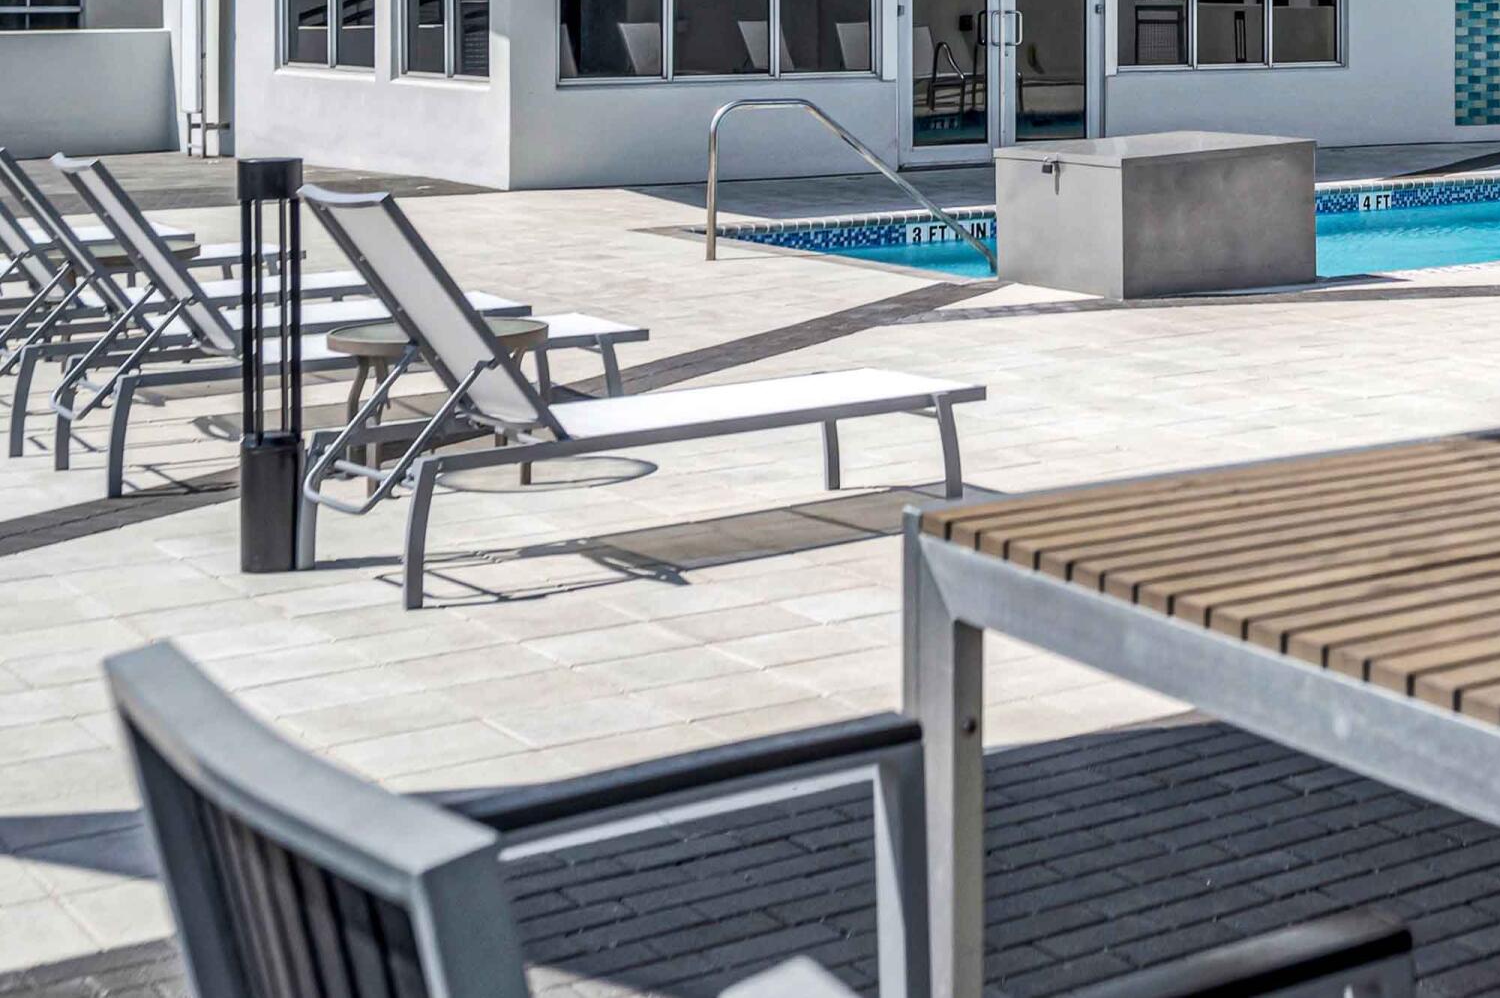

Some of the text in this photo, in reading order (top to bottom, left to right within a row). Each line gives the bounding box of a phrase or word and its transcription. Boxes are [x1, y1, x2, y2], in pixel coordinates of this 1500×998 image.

[1363, 195, 1371, 211] 4
[912, 226, 922, 244] 3
[929, 225, 948, 242] FT
